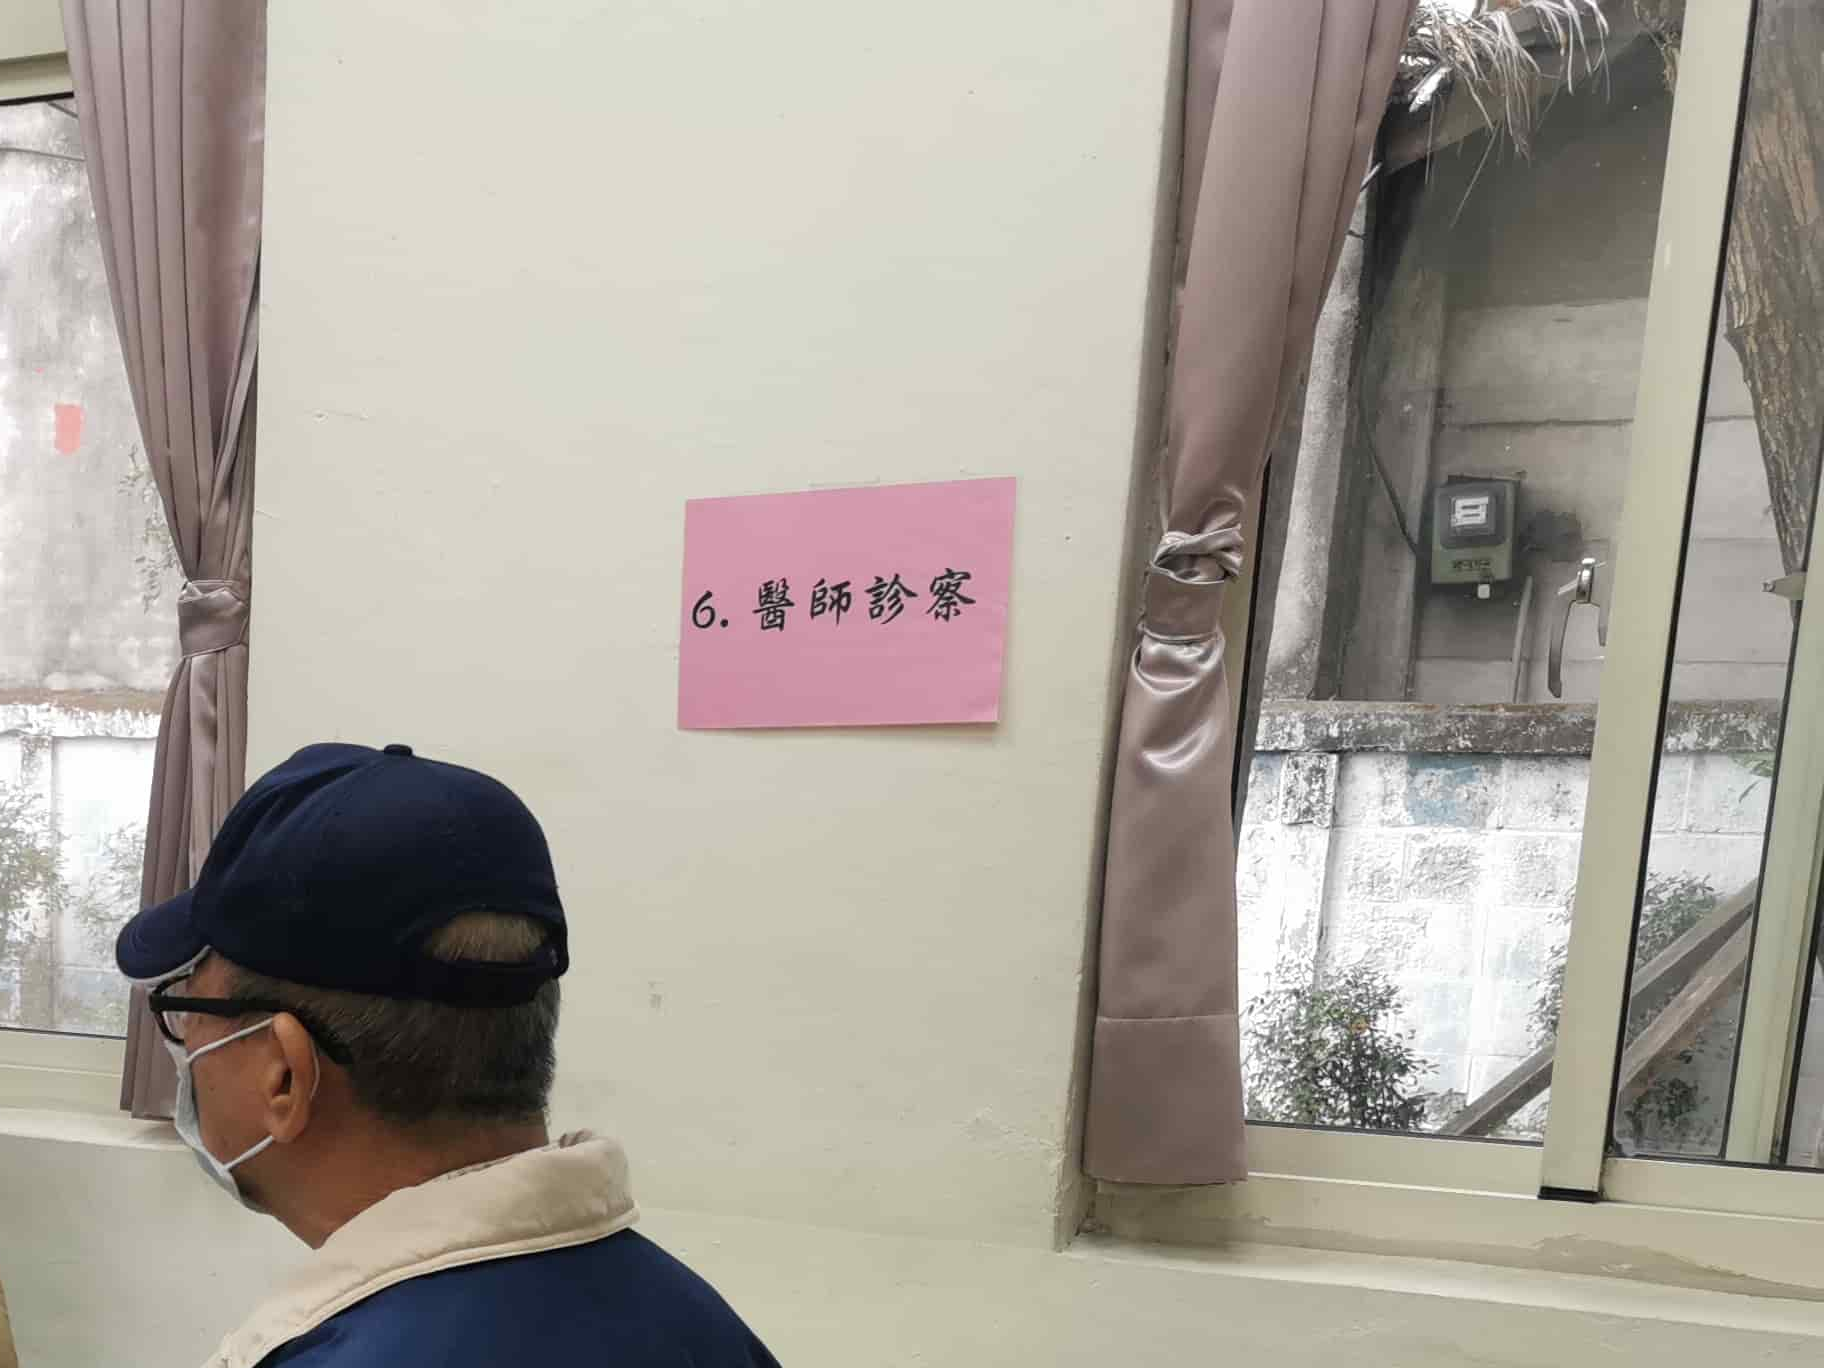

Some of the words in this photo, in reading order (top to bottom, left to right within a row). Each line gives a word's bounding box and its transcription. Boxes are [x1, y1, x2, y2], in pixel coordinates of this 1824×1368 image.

[691, 591, 730, 629] 6.
[752, 567, 978, 632] 醫師診察
